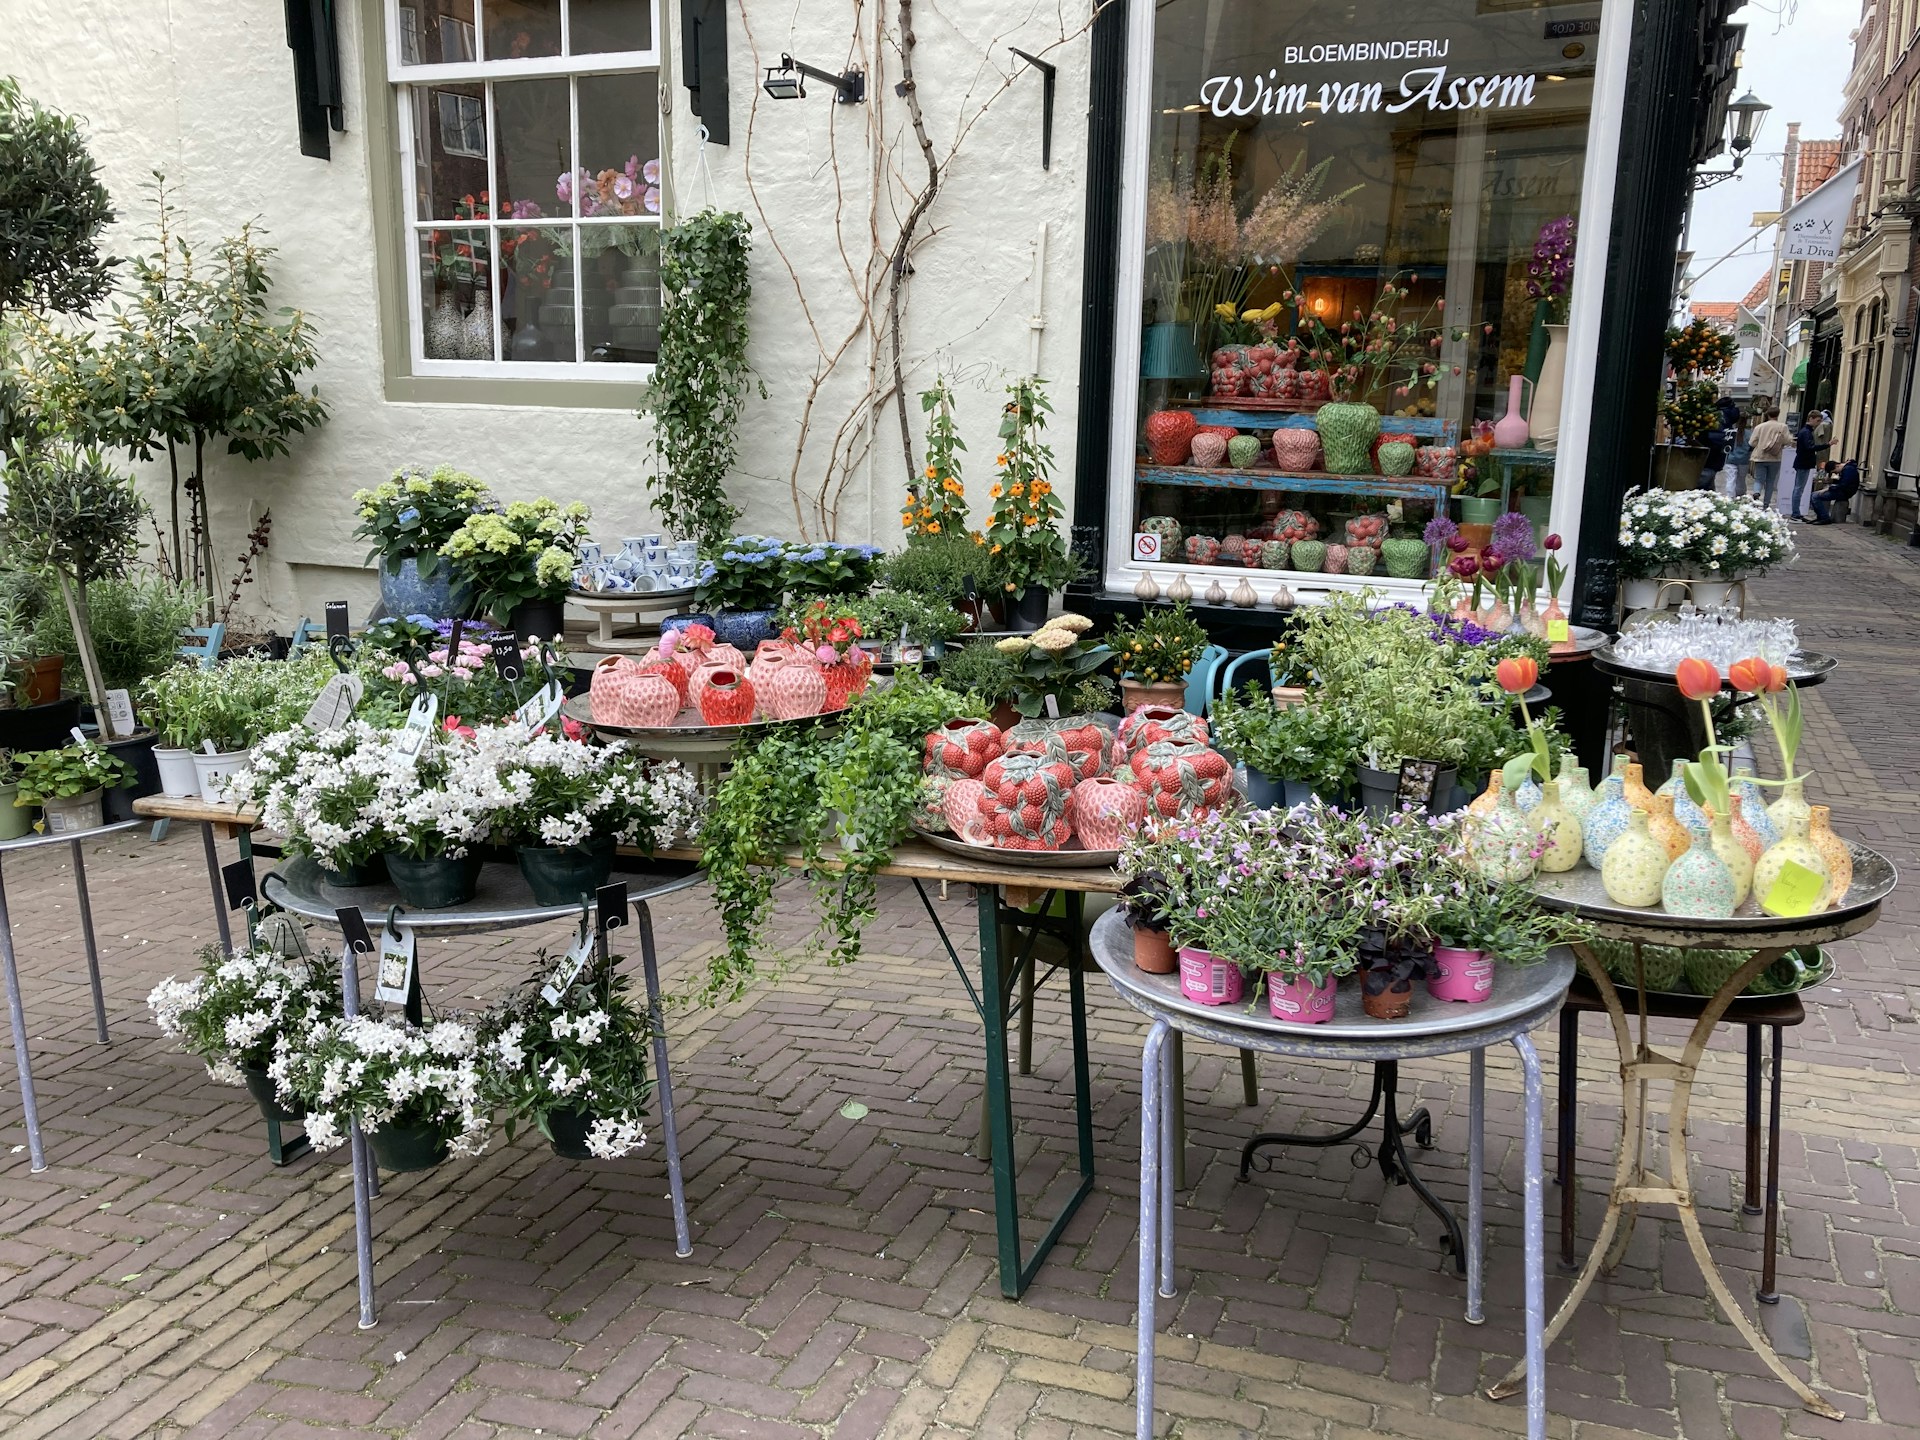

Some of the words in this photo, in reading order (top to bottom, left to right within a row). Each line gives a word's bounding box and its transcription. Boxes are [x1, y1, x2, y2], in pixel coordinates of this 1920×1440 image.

[1284, 38, 1450, 64] BLOEMBINDERIJ
[1200, 68, 1308, 117] Wim
[1317, 81, 1383, 115] van
[1385, 65, 1536, 113] Assem
[1789, 244, 1803, 254] La
[1807, 245, 1834, 257] Diva
